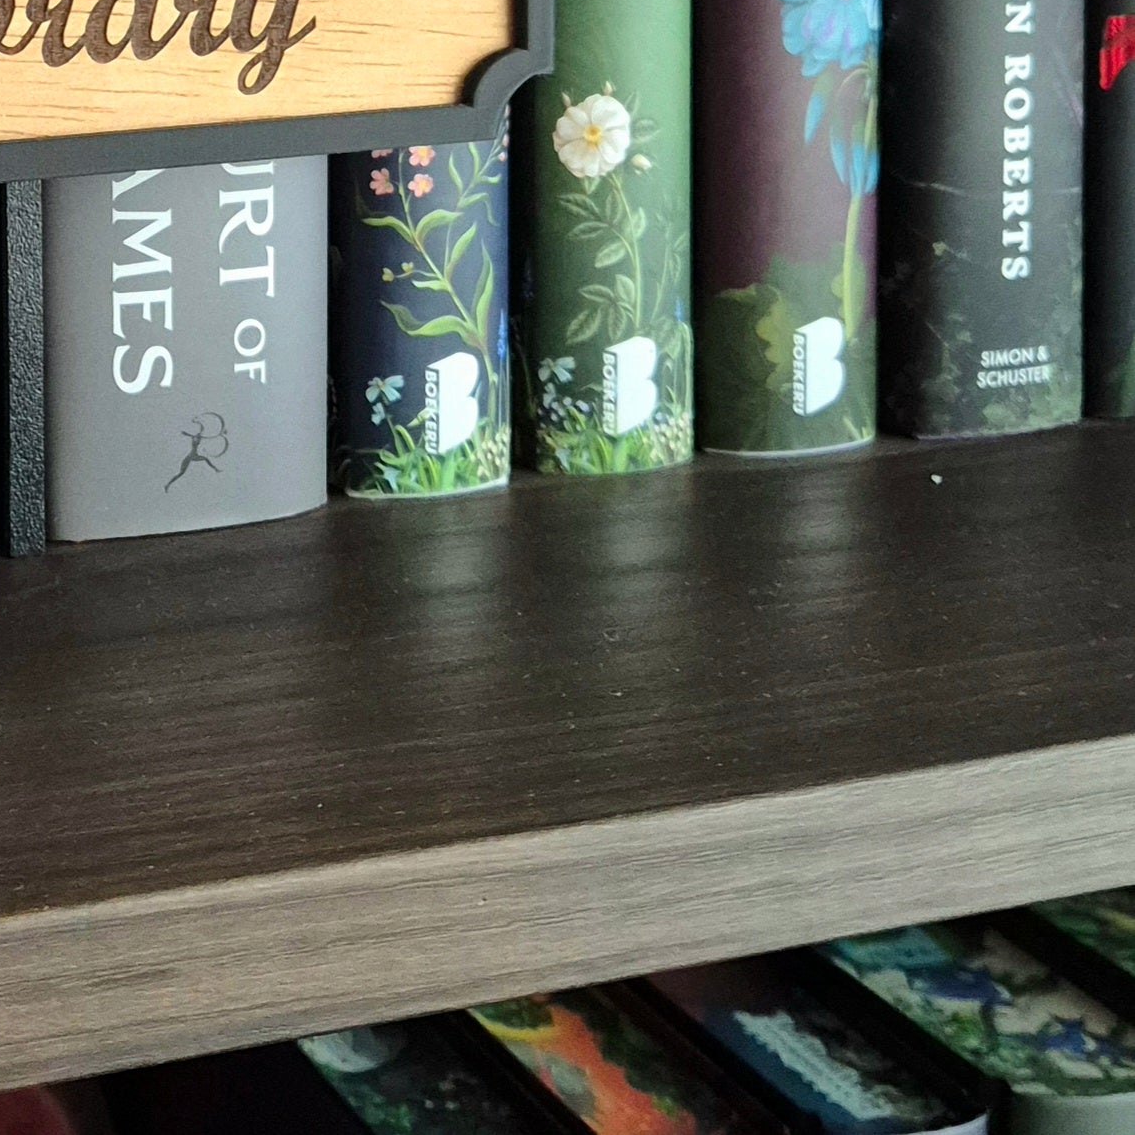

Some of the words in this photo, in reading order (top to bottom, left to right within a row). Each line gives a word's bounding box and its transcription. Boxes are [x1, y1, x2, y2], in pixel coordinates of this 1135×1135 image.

[1001, 53, 1034, 281] ROBERTS
[233, 318, 267, 384] OF
[980, 347, 1034, 368] SIMON
[1037, 345, 1050, 362] &
[976, 365, 1051, 388] SCHUSTER
